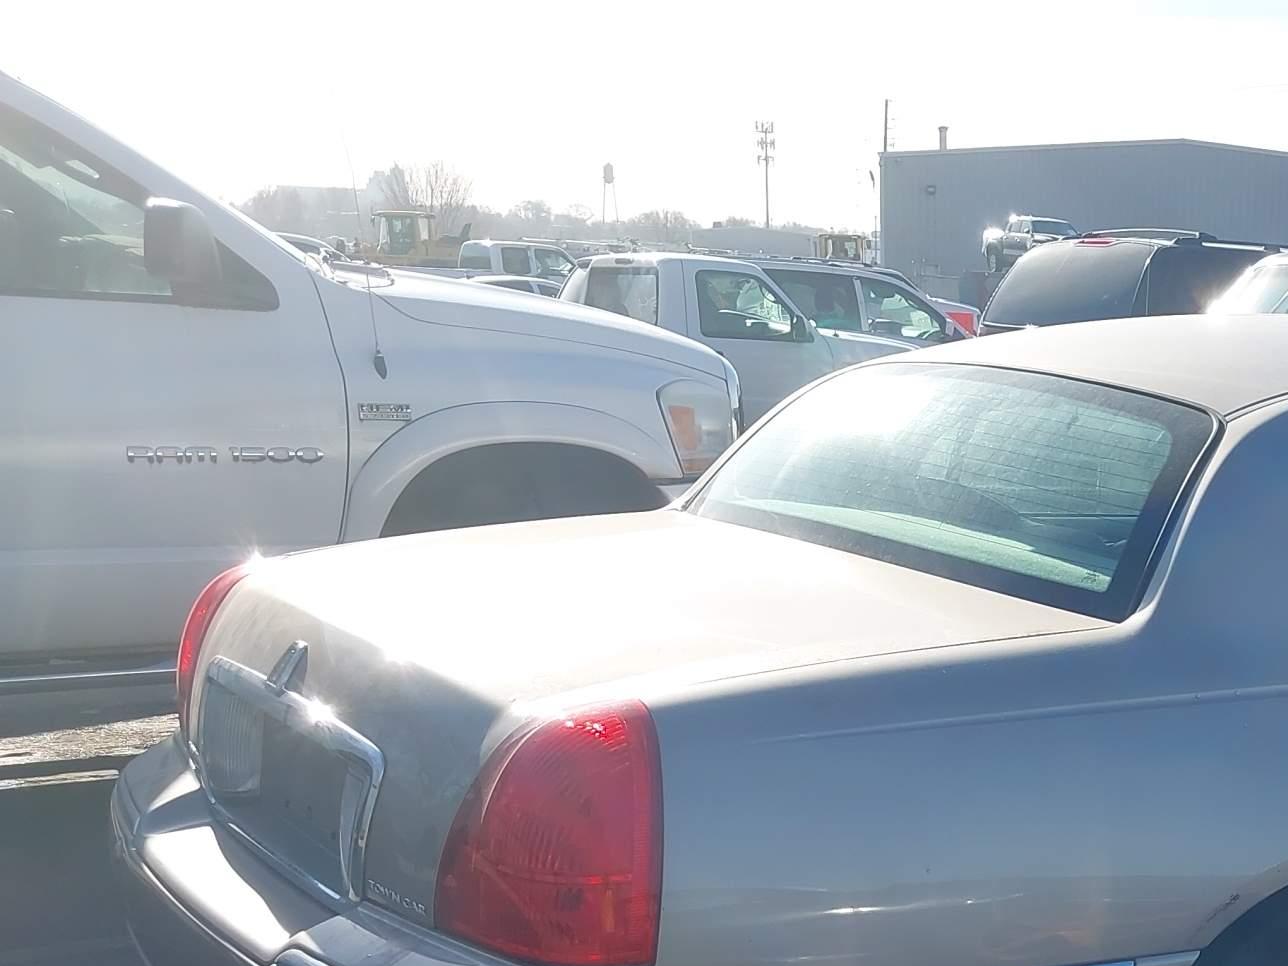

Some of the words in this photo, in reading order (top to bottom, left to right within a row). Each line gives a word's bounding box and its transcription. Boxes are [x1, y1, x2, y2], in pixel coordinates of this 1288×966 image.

[126, 445, 218, 464] RAM
[228, 445, 325, 464] 1500
[368, 879, 401, 904] TOWN
[402, 896, 426, 915] CAR
